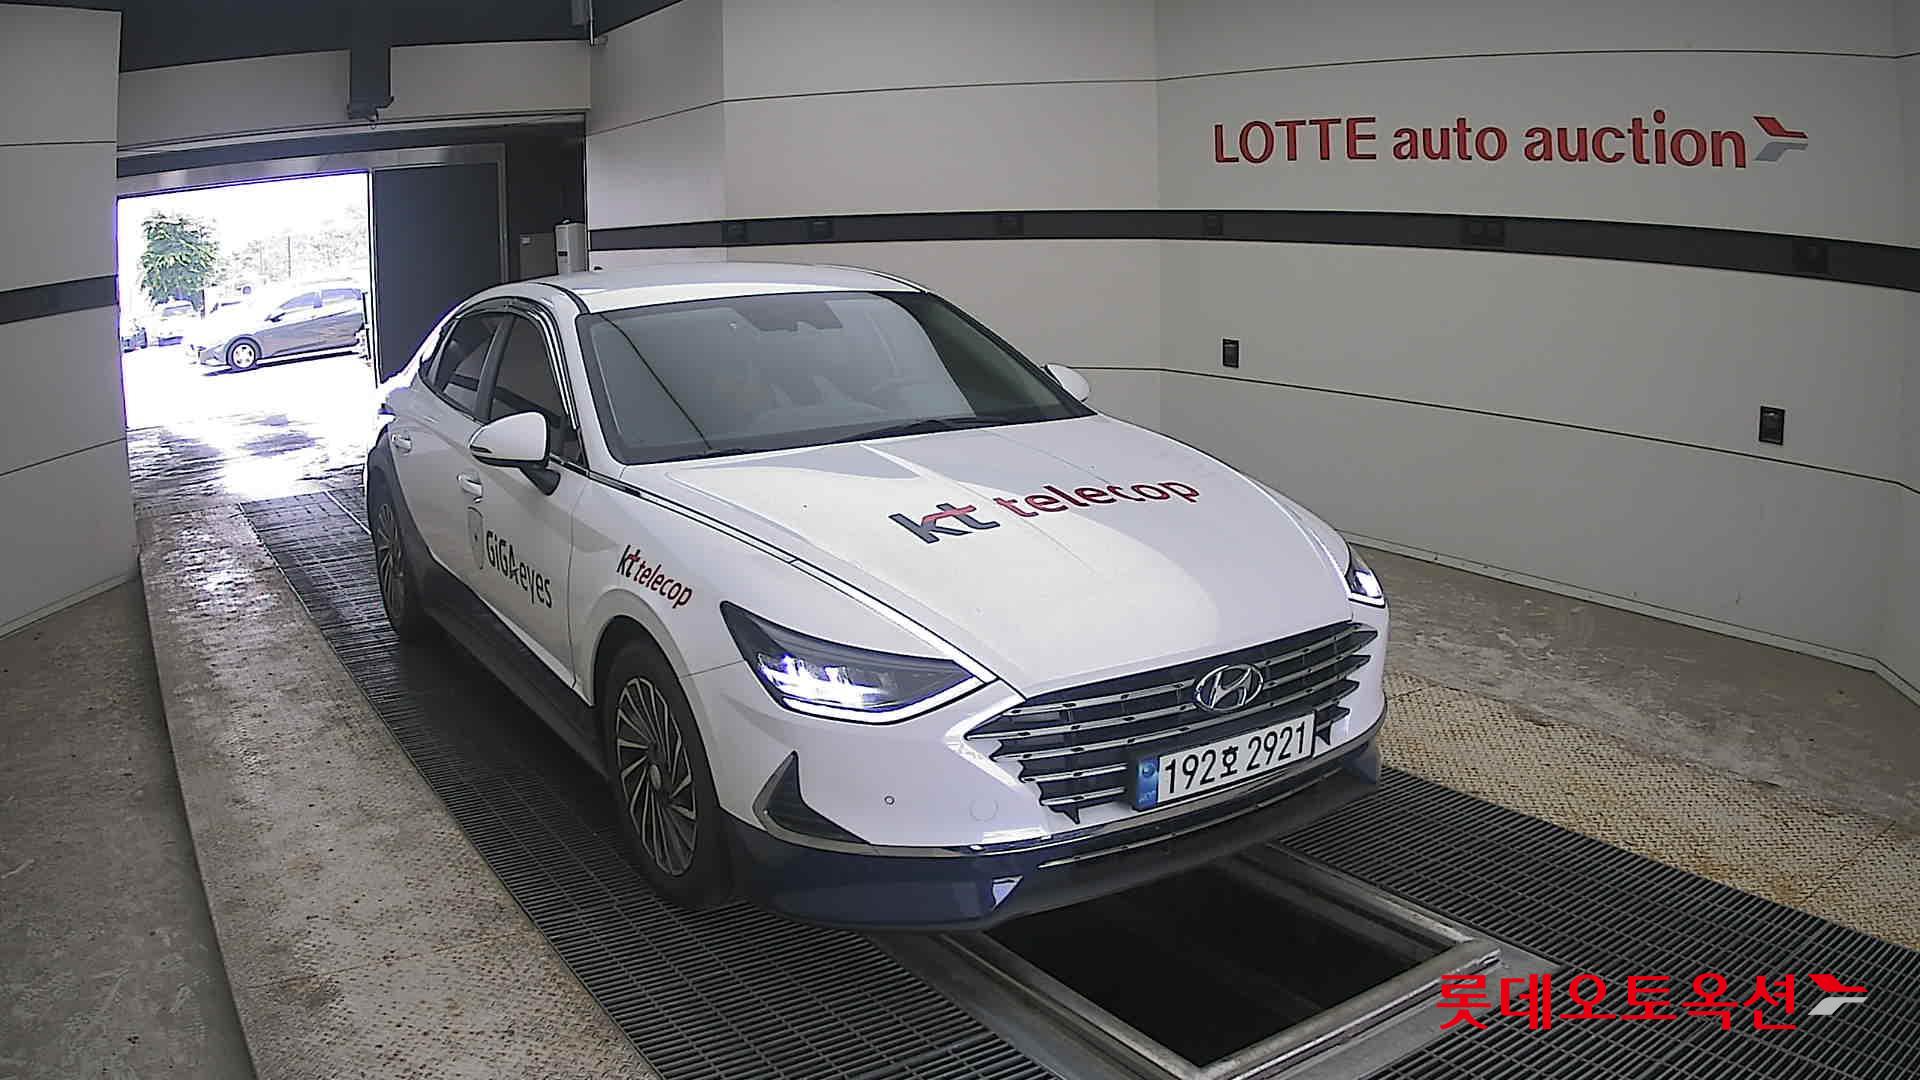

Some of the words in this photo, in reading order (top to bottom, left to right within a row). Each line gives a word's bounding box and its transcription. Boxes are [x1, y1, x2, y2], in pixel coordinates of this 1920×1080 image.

[1213, 115, 1378, 163] LOTTE
[1392, 116, 1508, 162] auto
[1523, 109, 1747, 169] auction
[888, 502, 1000, 544] kt
[993, 481, 1200, 518] telecop
[616, 544, 641, 578] kt
[633, 564, 692, 609] telecop
[1164, 745, 1239, 794] 192호
[1246, 720, 1306, 772] 2921
